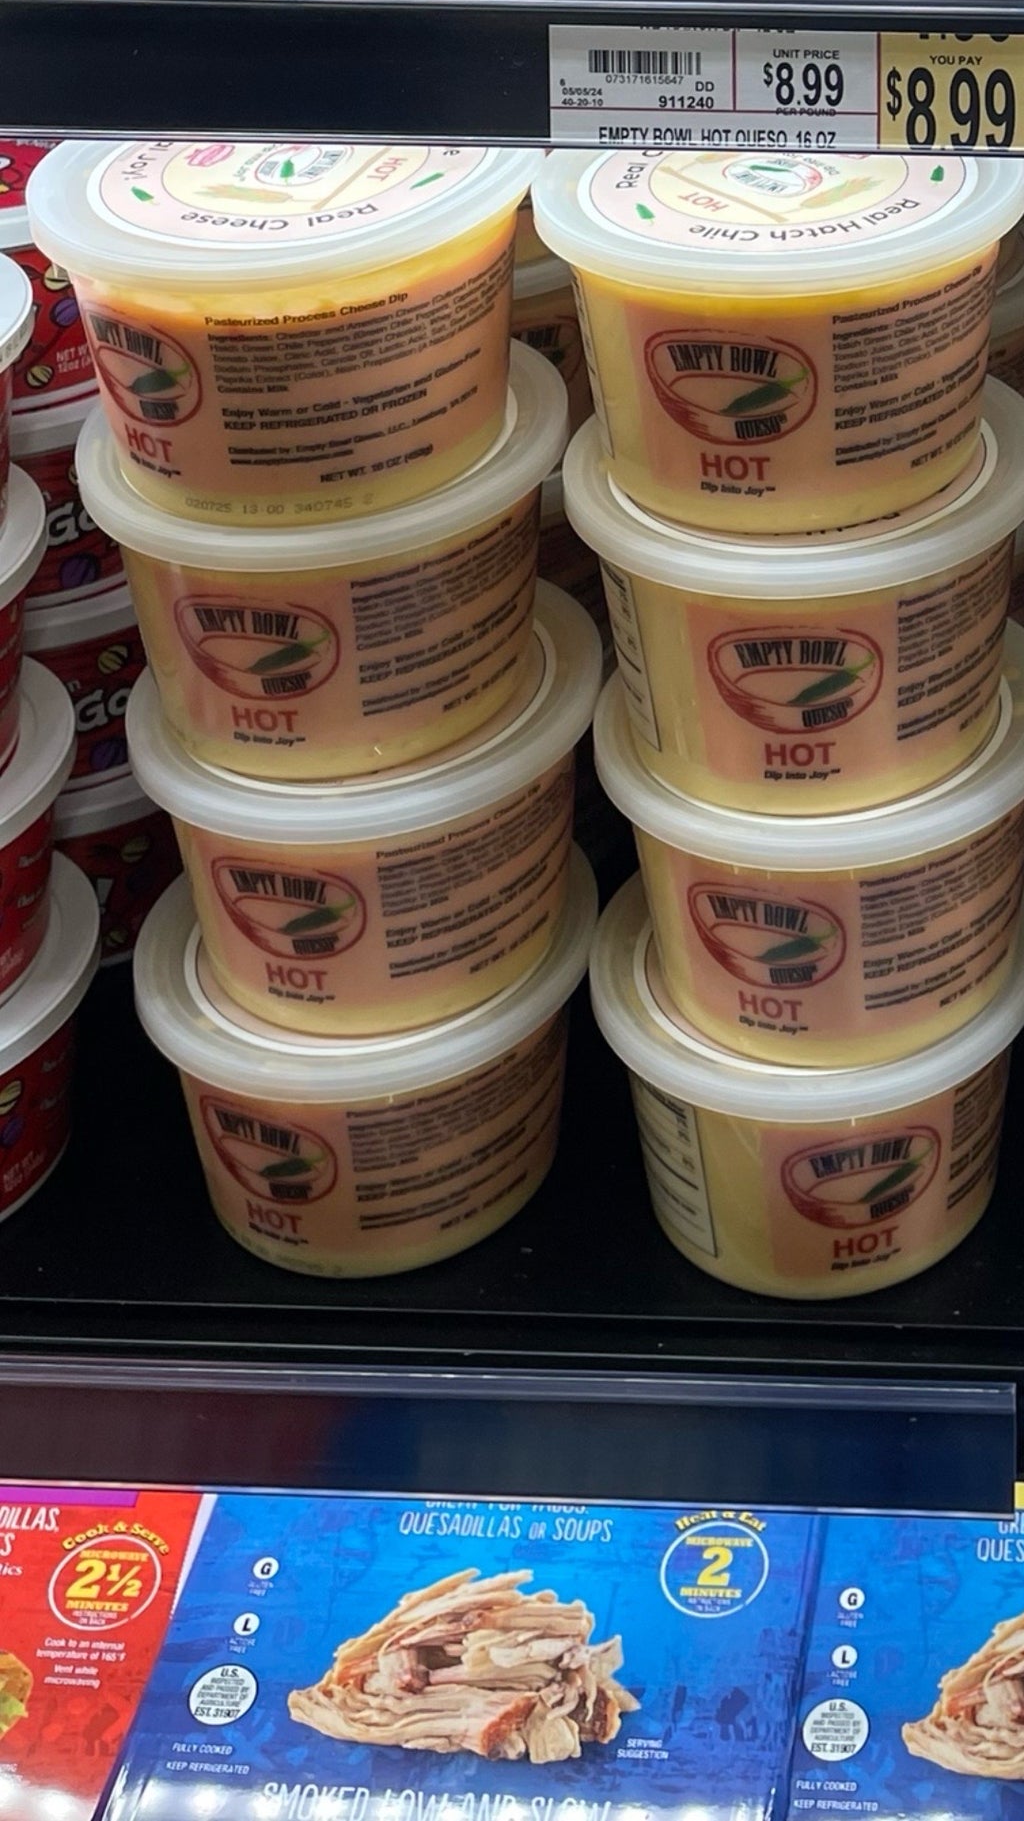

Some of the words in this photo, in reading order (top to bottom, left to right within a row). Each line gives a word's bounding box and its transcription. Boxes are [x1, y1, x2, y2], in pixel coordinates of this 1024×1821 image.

[773, 49, 800, 60] UNIT
[803, 50, 840, 60] PRICE
[930, 55, 956, 66] YOU
[958, 56, 982, 66] PAY
[695, 82, 715, 92] DD
[763, 62, 844, 107] $8.99
[658, 95, 714, 109] 911240
[886, 66, 1016, 152] $8.99
[599, 126, 649, 145] EMPTY
[653, 128, 692, 146] BOWL
[701, 129, 731, 147] HOT
[816, 131, 836, 149] OZ
[180, 210, 289, 231] Cheese
[307, 202, 380, 227] Real
[865, 196, 921, 226] Real
[689, 223, 760, 242] Chile
[769, 216, 861, 242] Hatch
[124, 423, 173, 464] HOT
[701, 452, 770, 481] HOT
[230, 705, 299, 733] HOT
[764, 741, 837, 768] HOT
[265, 962, 328, 993] HOT
[737, 989, 803, 1022] HOT
[246, 1199, 302, 1234] HOT
[832, 1225, 899, 1258] HOT
[62, 1524, 110, 1551] Cook
[113, 1521, 128, 1534] &
[130, 1523, 171, 1556] Serve
[399, 1511, 523, 1539] QUESADILLAS
[529, 1521, 547, 1539] OR
[552, 1517, 613, 1542] SOUPS
[696, 1546, 734, 1586] 2
[66, 1600, 129, 1612] MINUTES
[679, 1587, 743, 1599] MINUTES
[172, 1743, 198, 1754] FULLY
[199, 1744, 232, 1755] COOKED
